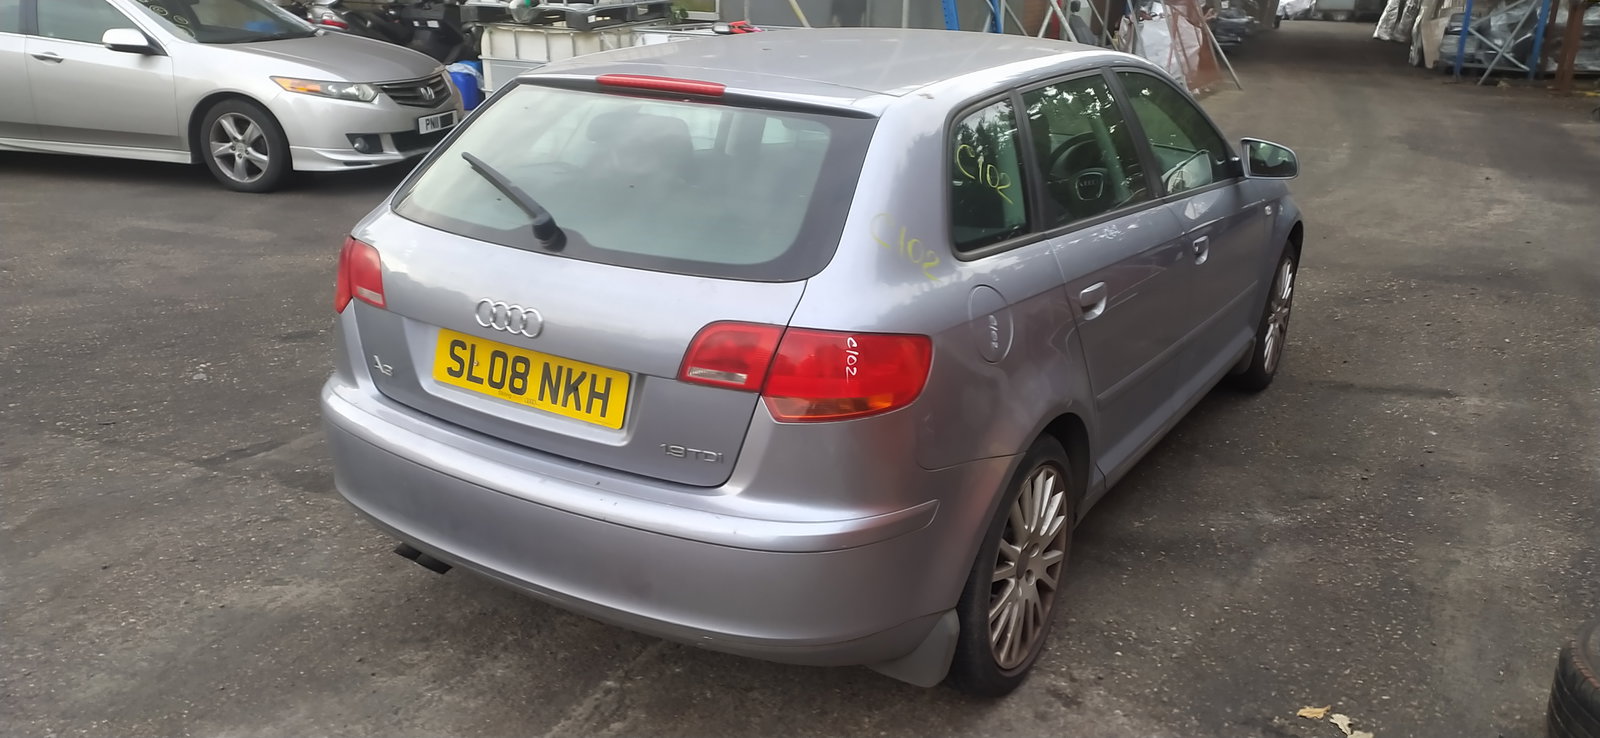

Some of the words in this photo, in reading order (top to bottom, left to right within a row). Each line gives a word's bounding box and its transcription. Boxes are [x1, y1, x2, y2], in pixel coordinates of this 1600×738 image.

[956, 144, 1014, 205] C102
[869, 212, 942, 283] C102
[373, 354, 393, 377] A3
[446, 339, 531, 396] SL08
[538, 361, 613, 418] NKH
[845, 336, 859, 384] C102
